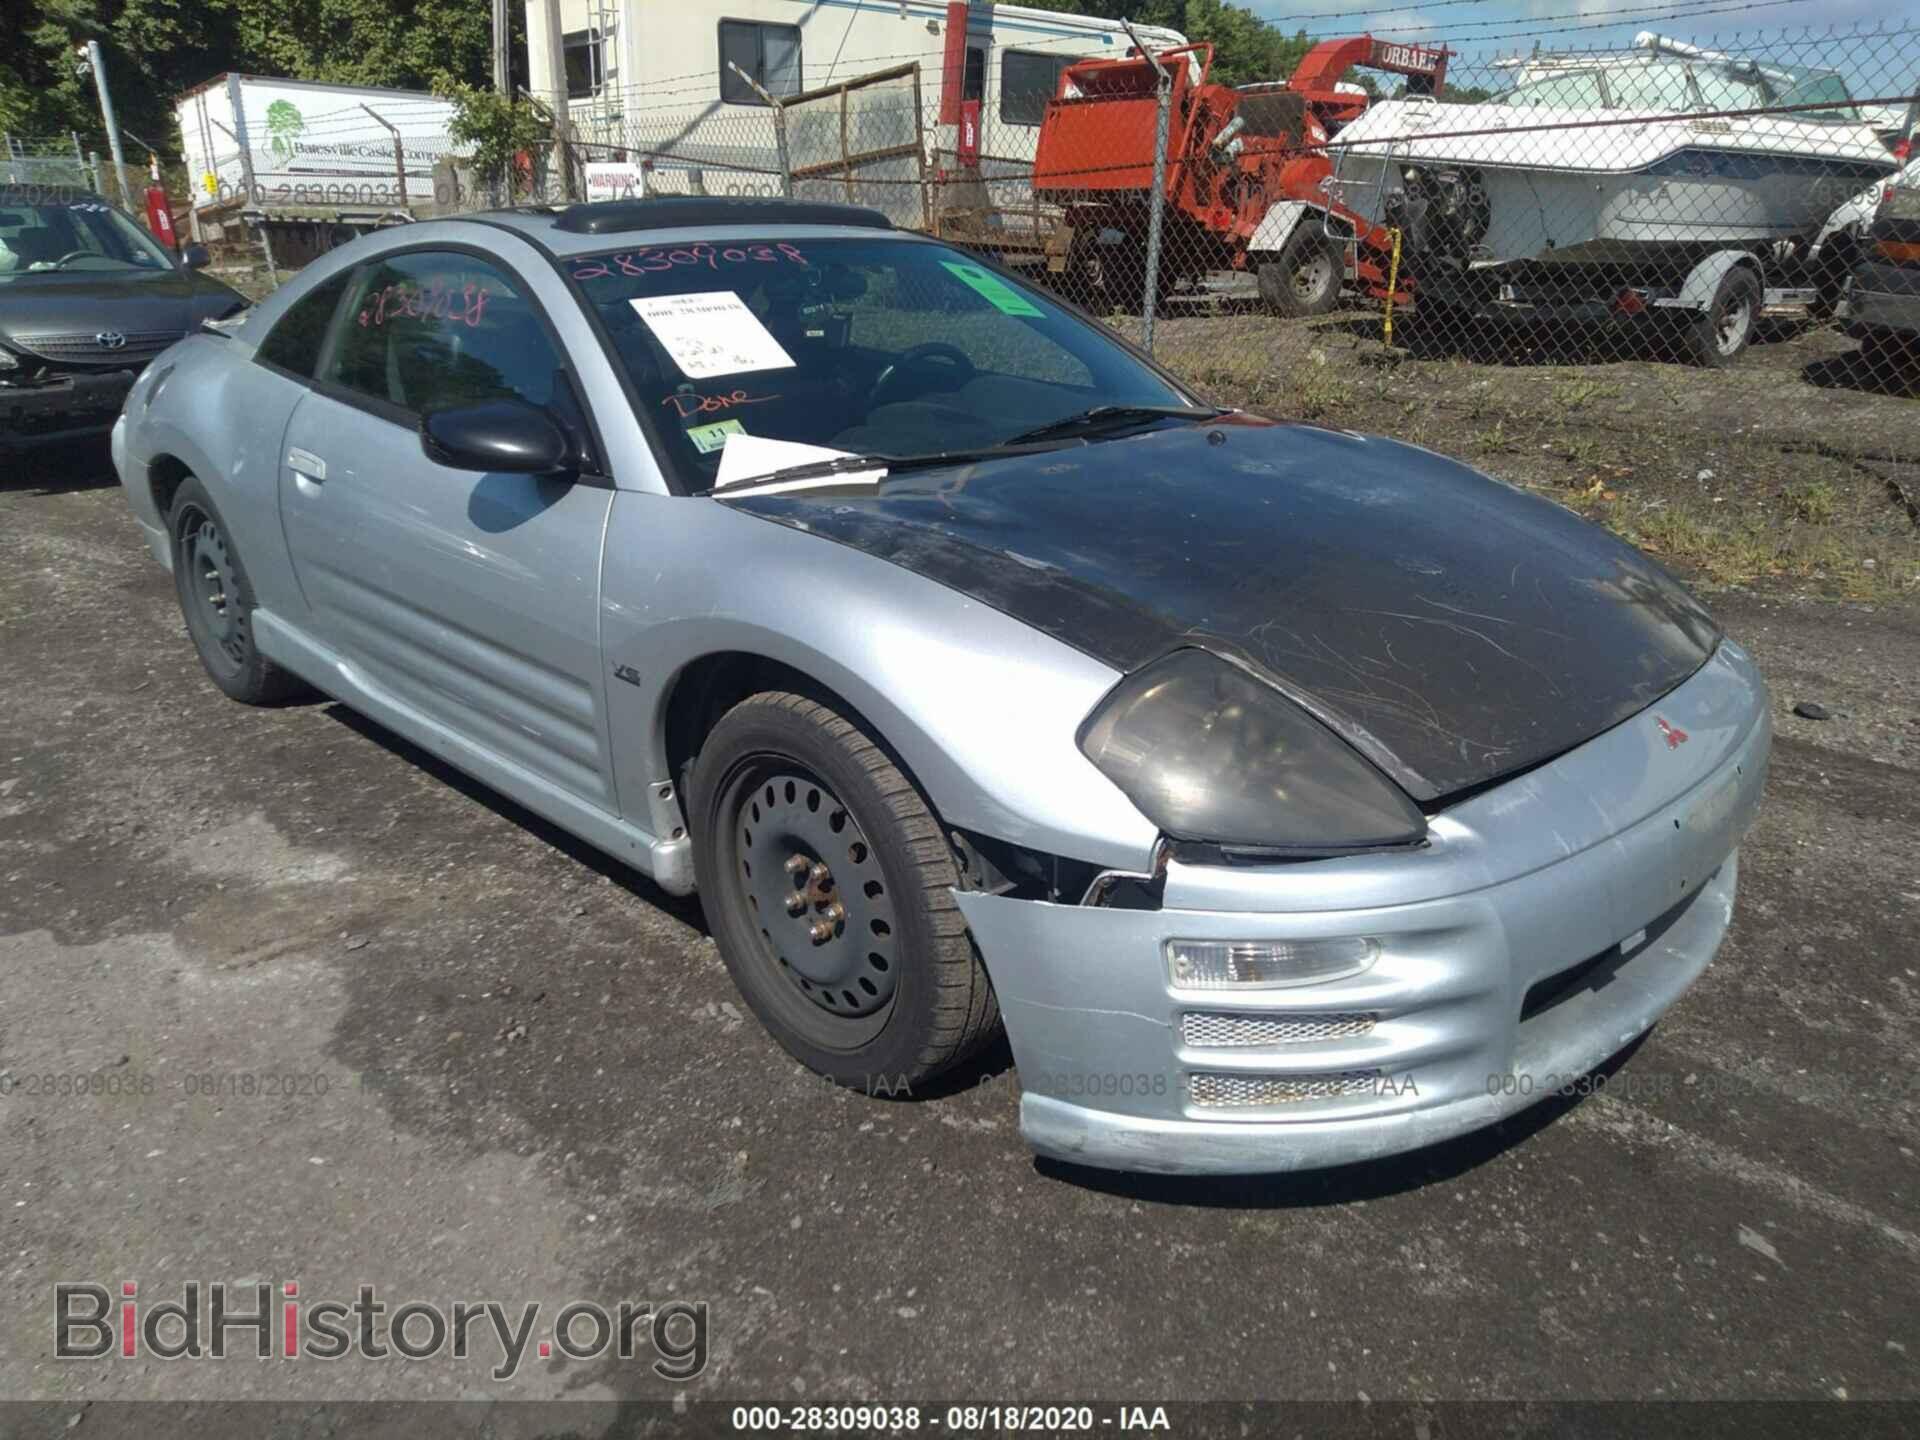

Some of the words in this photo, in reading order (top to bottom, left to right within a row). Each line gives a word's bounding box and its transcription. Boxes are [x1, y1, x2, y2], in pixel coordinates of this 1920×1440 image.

[295, 142, 358, 156] Batesville
[359, 145, 396, 159] Caske
[591, 173, 635, 188] WARNING
[572, 242, 808, 280] 28309038
[661, 391, 782, 416] Done
